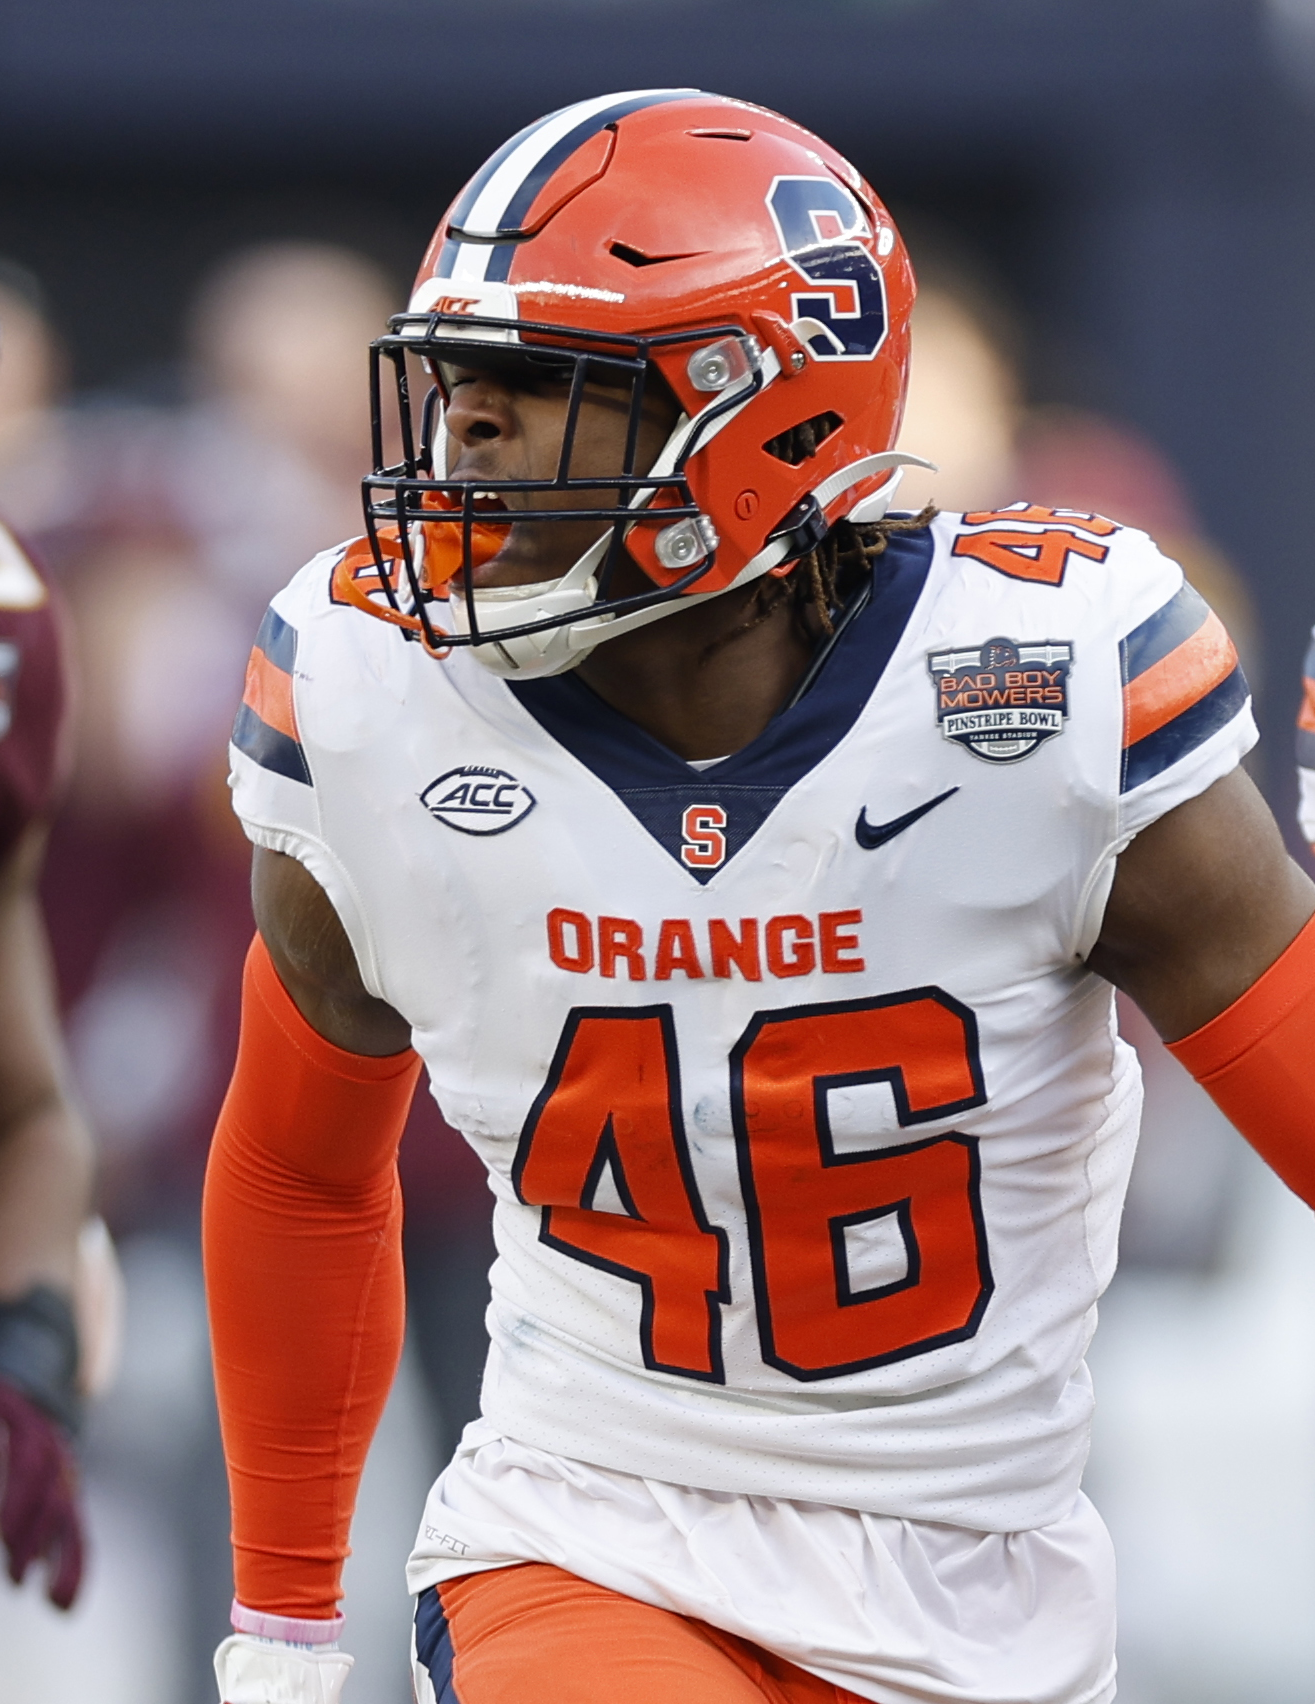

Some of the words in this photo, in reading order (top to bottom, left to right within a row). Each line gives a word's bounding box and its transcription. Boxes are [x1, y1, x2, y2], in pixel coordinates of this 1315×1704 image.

[765, 175, 889, 362] S
[426, 296, 481, 316] ACC
[940, 673, 997, 692] BAD
[1004, 670, 1062, 687] BOY
[940, 686, 1064, 709] MOWERS
[947, 711, 1013, 733] PINSTRIPE
[1019, 711, 1060, 727] BOWL
[436, 783, 520, 807] ACC
[680, 803, 727, 870] S
[546, 907, 867, 983] ORANGE
[511, 985, 995, 1385] 46
